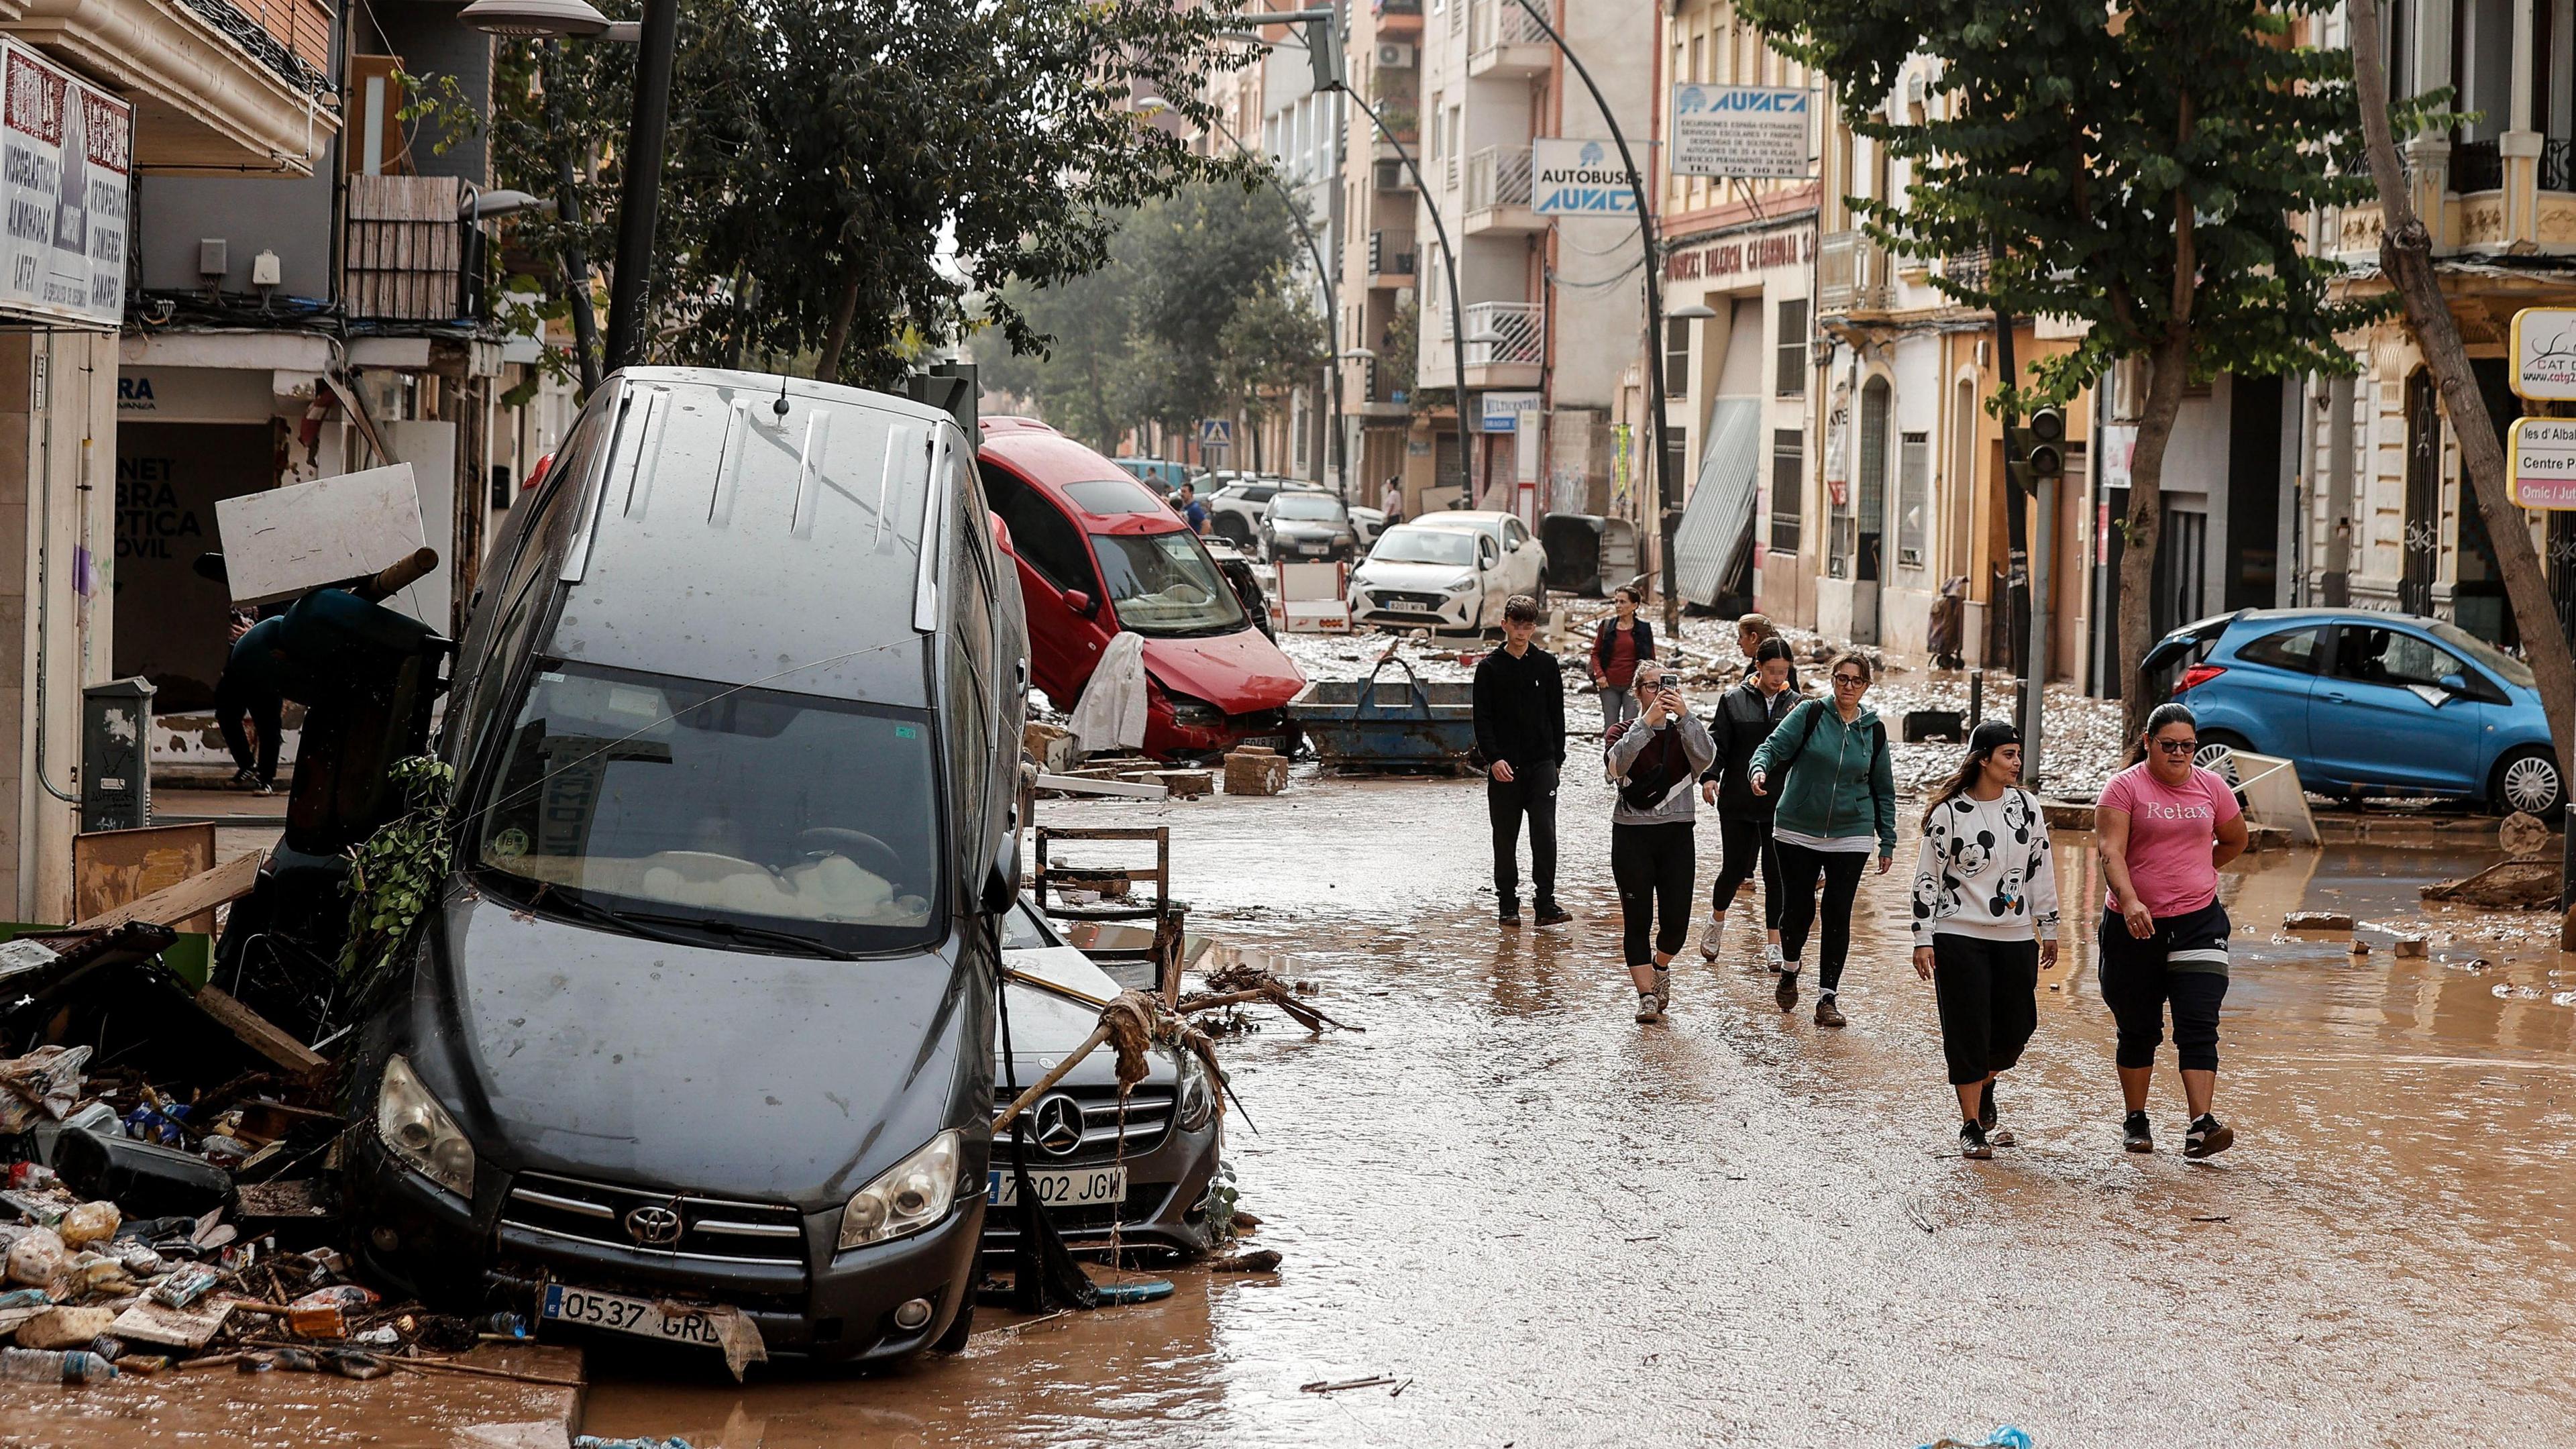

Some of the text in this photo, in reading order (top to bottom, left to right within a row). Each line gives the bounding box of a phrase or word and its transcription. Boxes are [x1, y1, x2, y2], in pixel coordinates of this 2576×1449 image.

[1709, 92, 1806, 112] AUVACA
[8, 198, 50, 245] ALMOHADAS
[93, 225, 121, 264] SOMIERES
[14, 253, 38, 292] LATEX
[92, 272, 118, 309] CANAPES
[2537, 360, 2565, 370] CAT
[2523, 457, 2563, 469] Centre
[2522, 485, 2550, 498] Omic
[2145, 802, 2209, 819] Relax
[1004, 1176, 1070, 1201] 702
[1079, 1172, 1121, 1200] JGW
[566, 1293, 646, 1328] 0537
